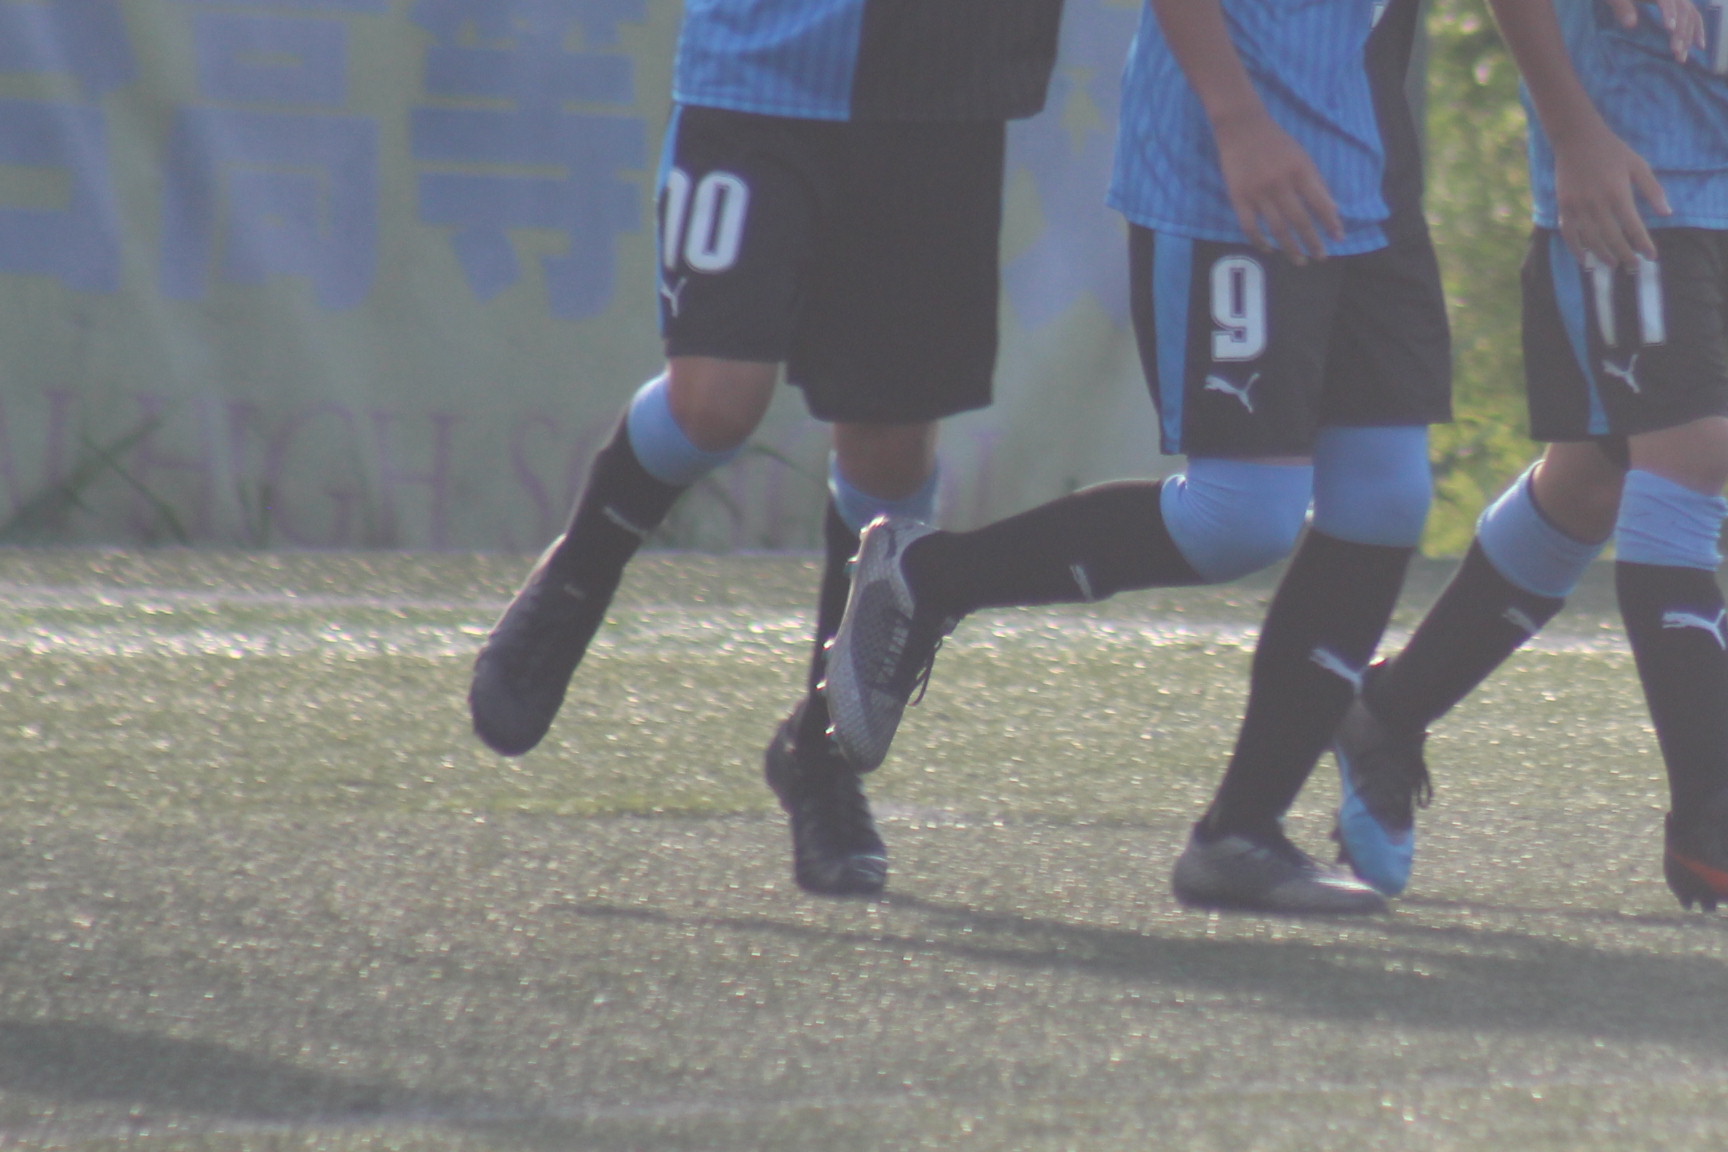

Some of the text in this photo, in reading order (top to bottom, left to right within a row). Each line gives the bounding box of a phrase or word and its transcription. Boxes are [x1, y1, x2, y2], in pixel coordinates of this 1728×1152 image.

[664, 169, 749, 273] 10
[1210, 255, 1267, 363] 9
[1583, 252, 1667, 348] 11
